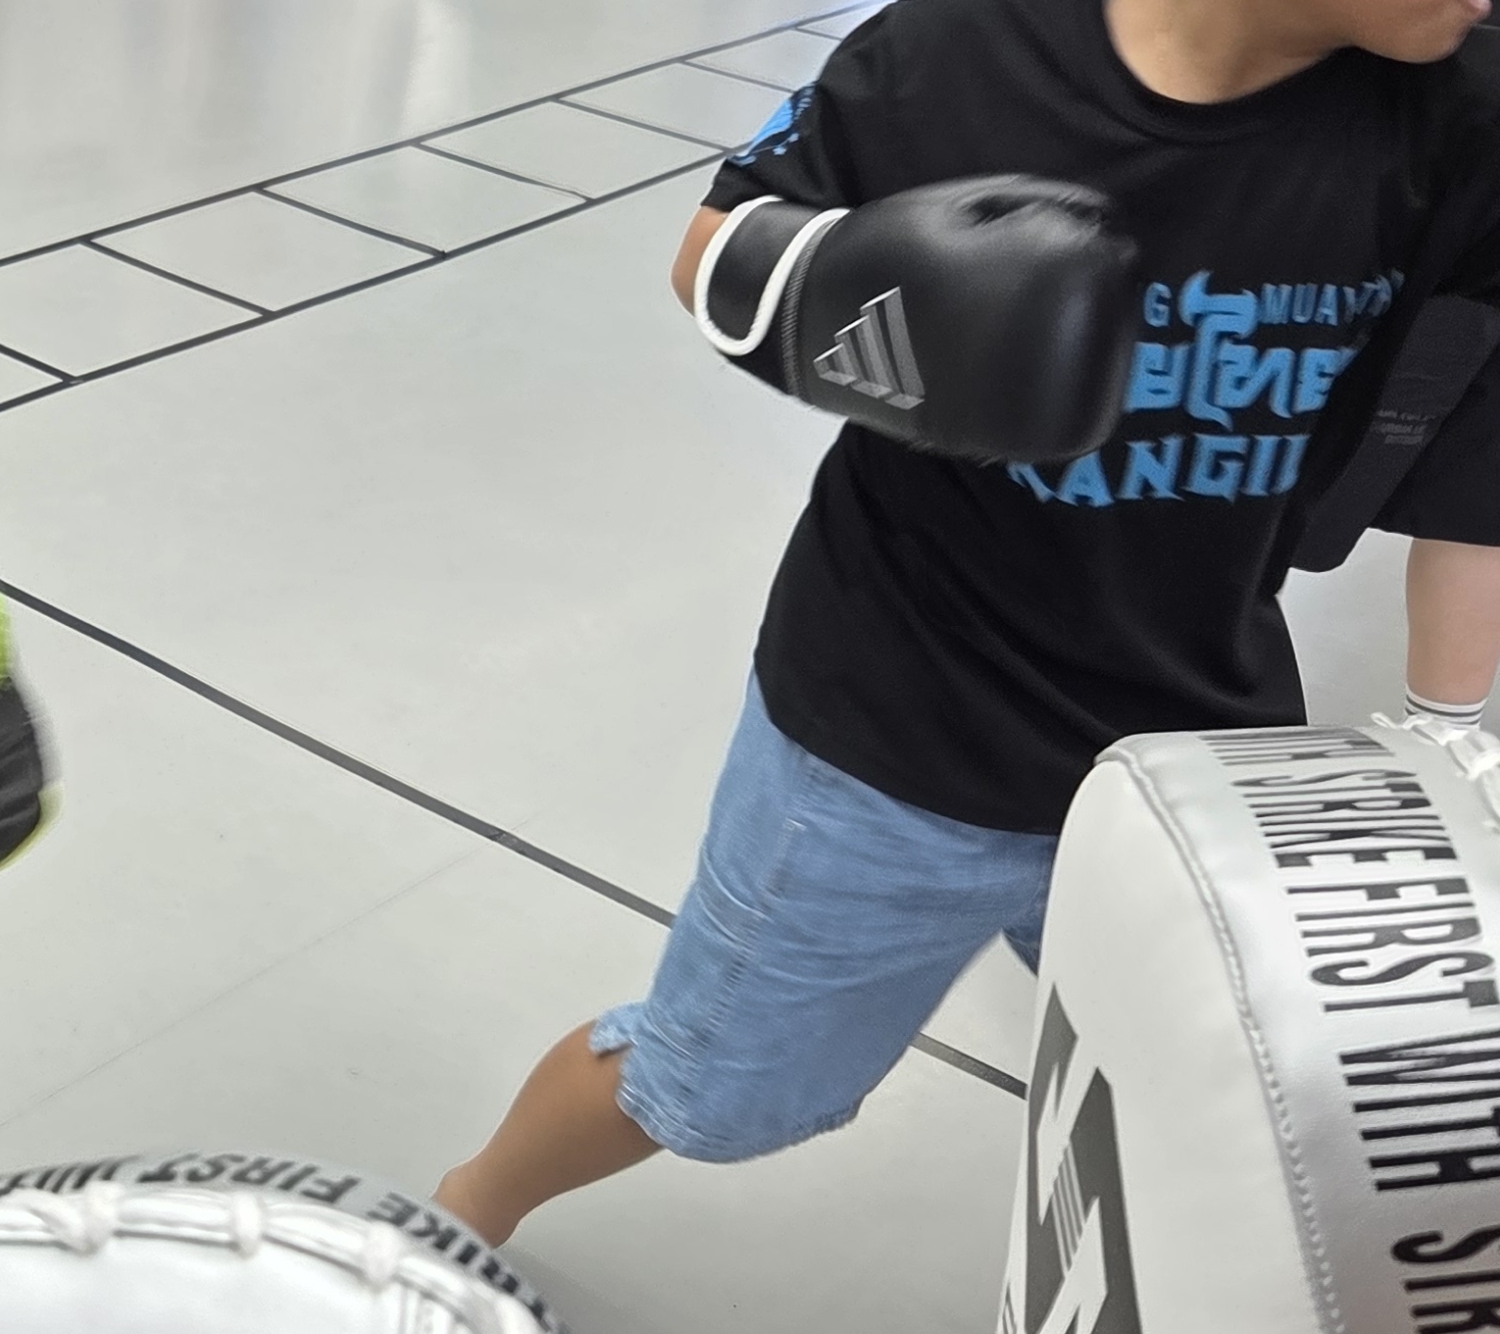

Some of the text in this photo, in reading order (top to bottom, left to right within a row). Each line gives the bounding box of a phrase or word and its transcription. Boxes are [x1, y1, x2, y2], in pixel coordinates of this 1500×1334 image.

[1230, 768, 1458, 869] STRIKE
[1285, 875, 1500, 1014] FIRST
[1338, 1029, 1500, 1193] WITH
[136, 1153, 362, 1205] FIRST
